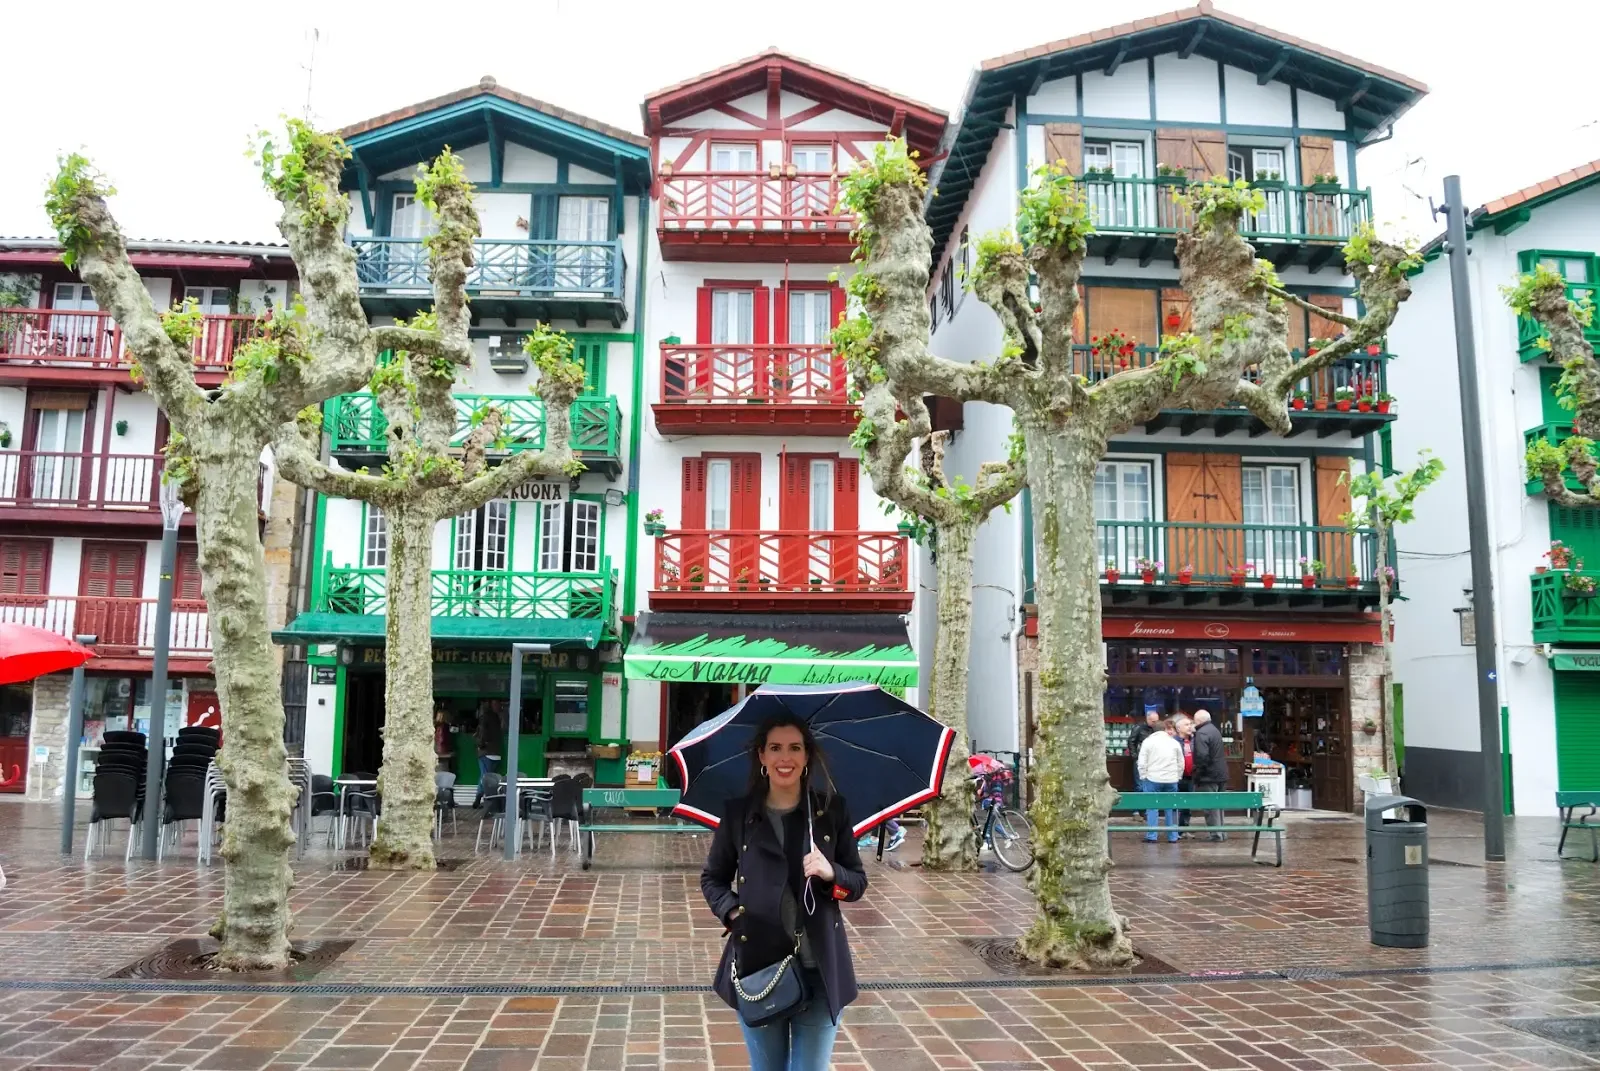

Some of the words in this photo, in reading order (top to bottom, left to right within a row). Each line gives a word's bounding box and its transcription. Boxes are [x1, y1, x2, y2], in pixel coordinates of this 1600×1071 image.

[1130, 621, 1175, 636] Jamones
[646, 660, 668, 679] La
[669, 661, 773, 683] Marina
